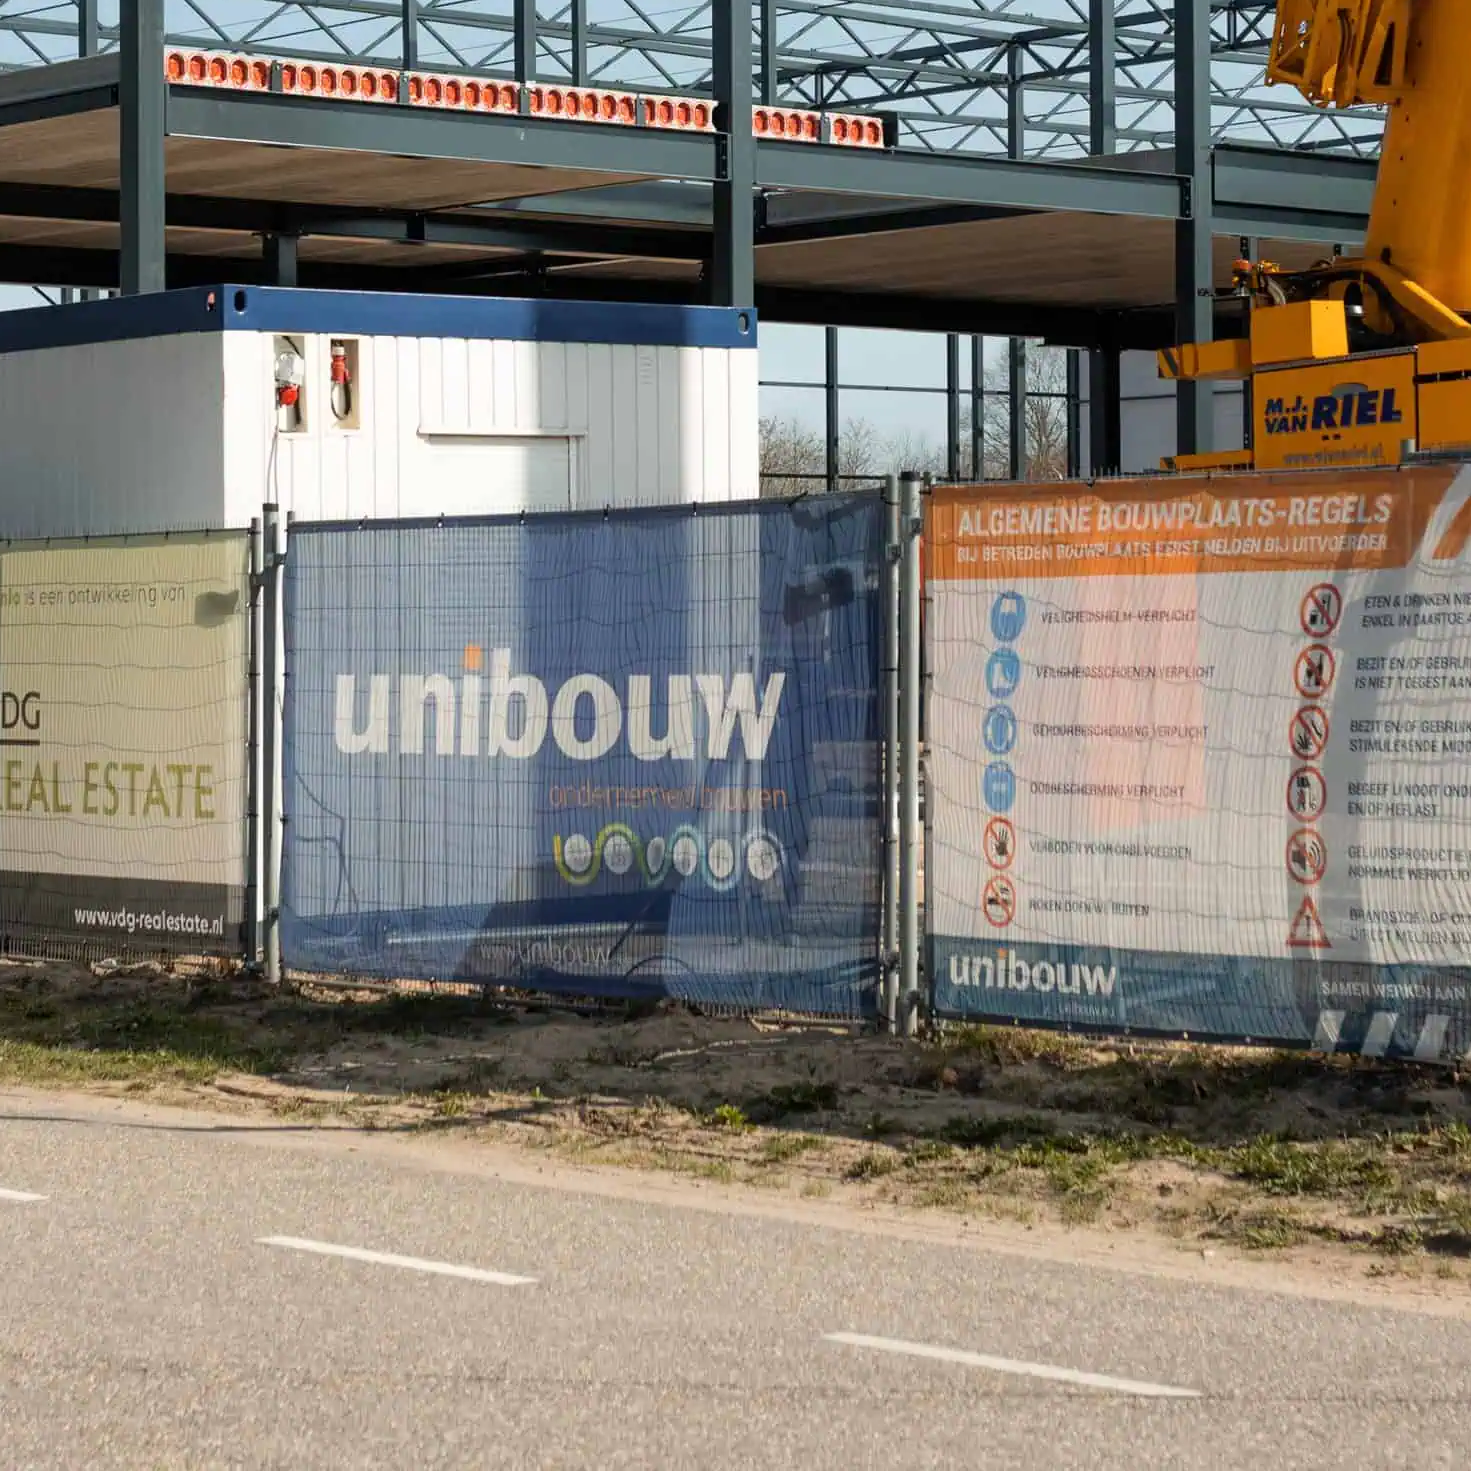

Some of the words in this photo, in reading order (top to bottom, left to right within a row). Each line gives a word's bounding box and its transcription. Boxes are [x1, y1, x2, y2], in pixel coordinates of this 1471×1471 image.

[1264, 395, 1309, 414] M.J.
[1264, 414, 1308, 434] VAN
[1311, 388, 1403, 431] RIEL
[958, 504, 1092, 537] ALGEMENE
[1096, 493, 1393, 531] BOUWPLAATS-REGELS
[957, 547, 978, 563] BIJ
[982, 543, 1054, 562] BETREDEN
[1056, 540, 1152, 561] BOUWPLAATS
[1203, 536, 1263, 556] MELDEN
[1264, 536, 1290, 553] BIJ
[1292, 532, 1388, 553] UITVOERDER
[39, 590, 65, 606] een
[68, 584, 157, 608] ontwikkeling
[162, 585, 186, 602] van
[1364, 594, 1391, 609] ETEN
[1362, 614, 1395, 628] ENKEL
[1398, 613, 1412, 627] IN
[1356, 656, 1385, 671] BEZIT
[1354, 676, 1366, 689] IS
[1367, 676, 1393, 689] NIET
[335, 643, 786, 761] unibouw
[81, 761, 215, 819] ESTATE
[74, 905, 224, 937] www.vdg-realestate.nl
[949, 946, 1117, 997] unibouw
